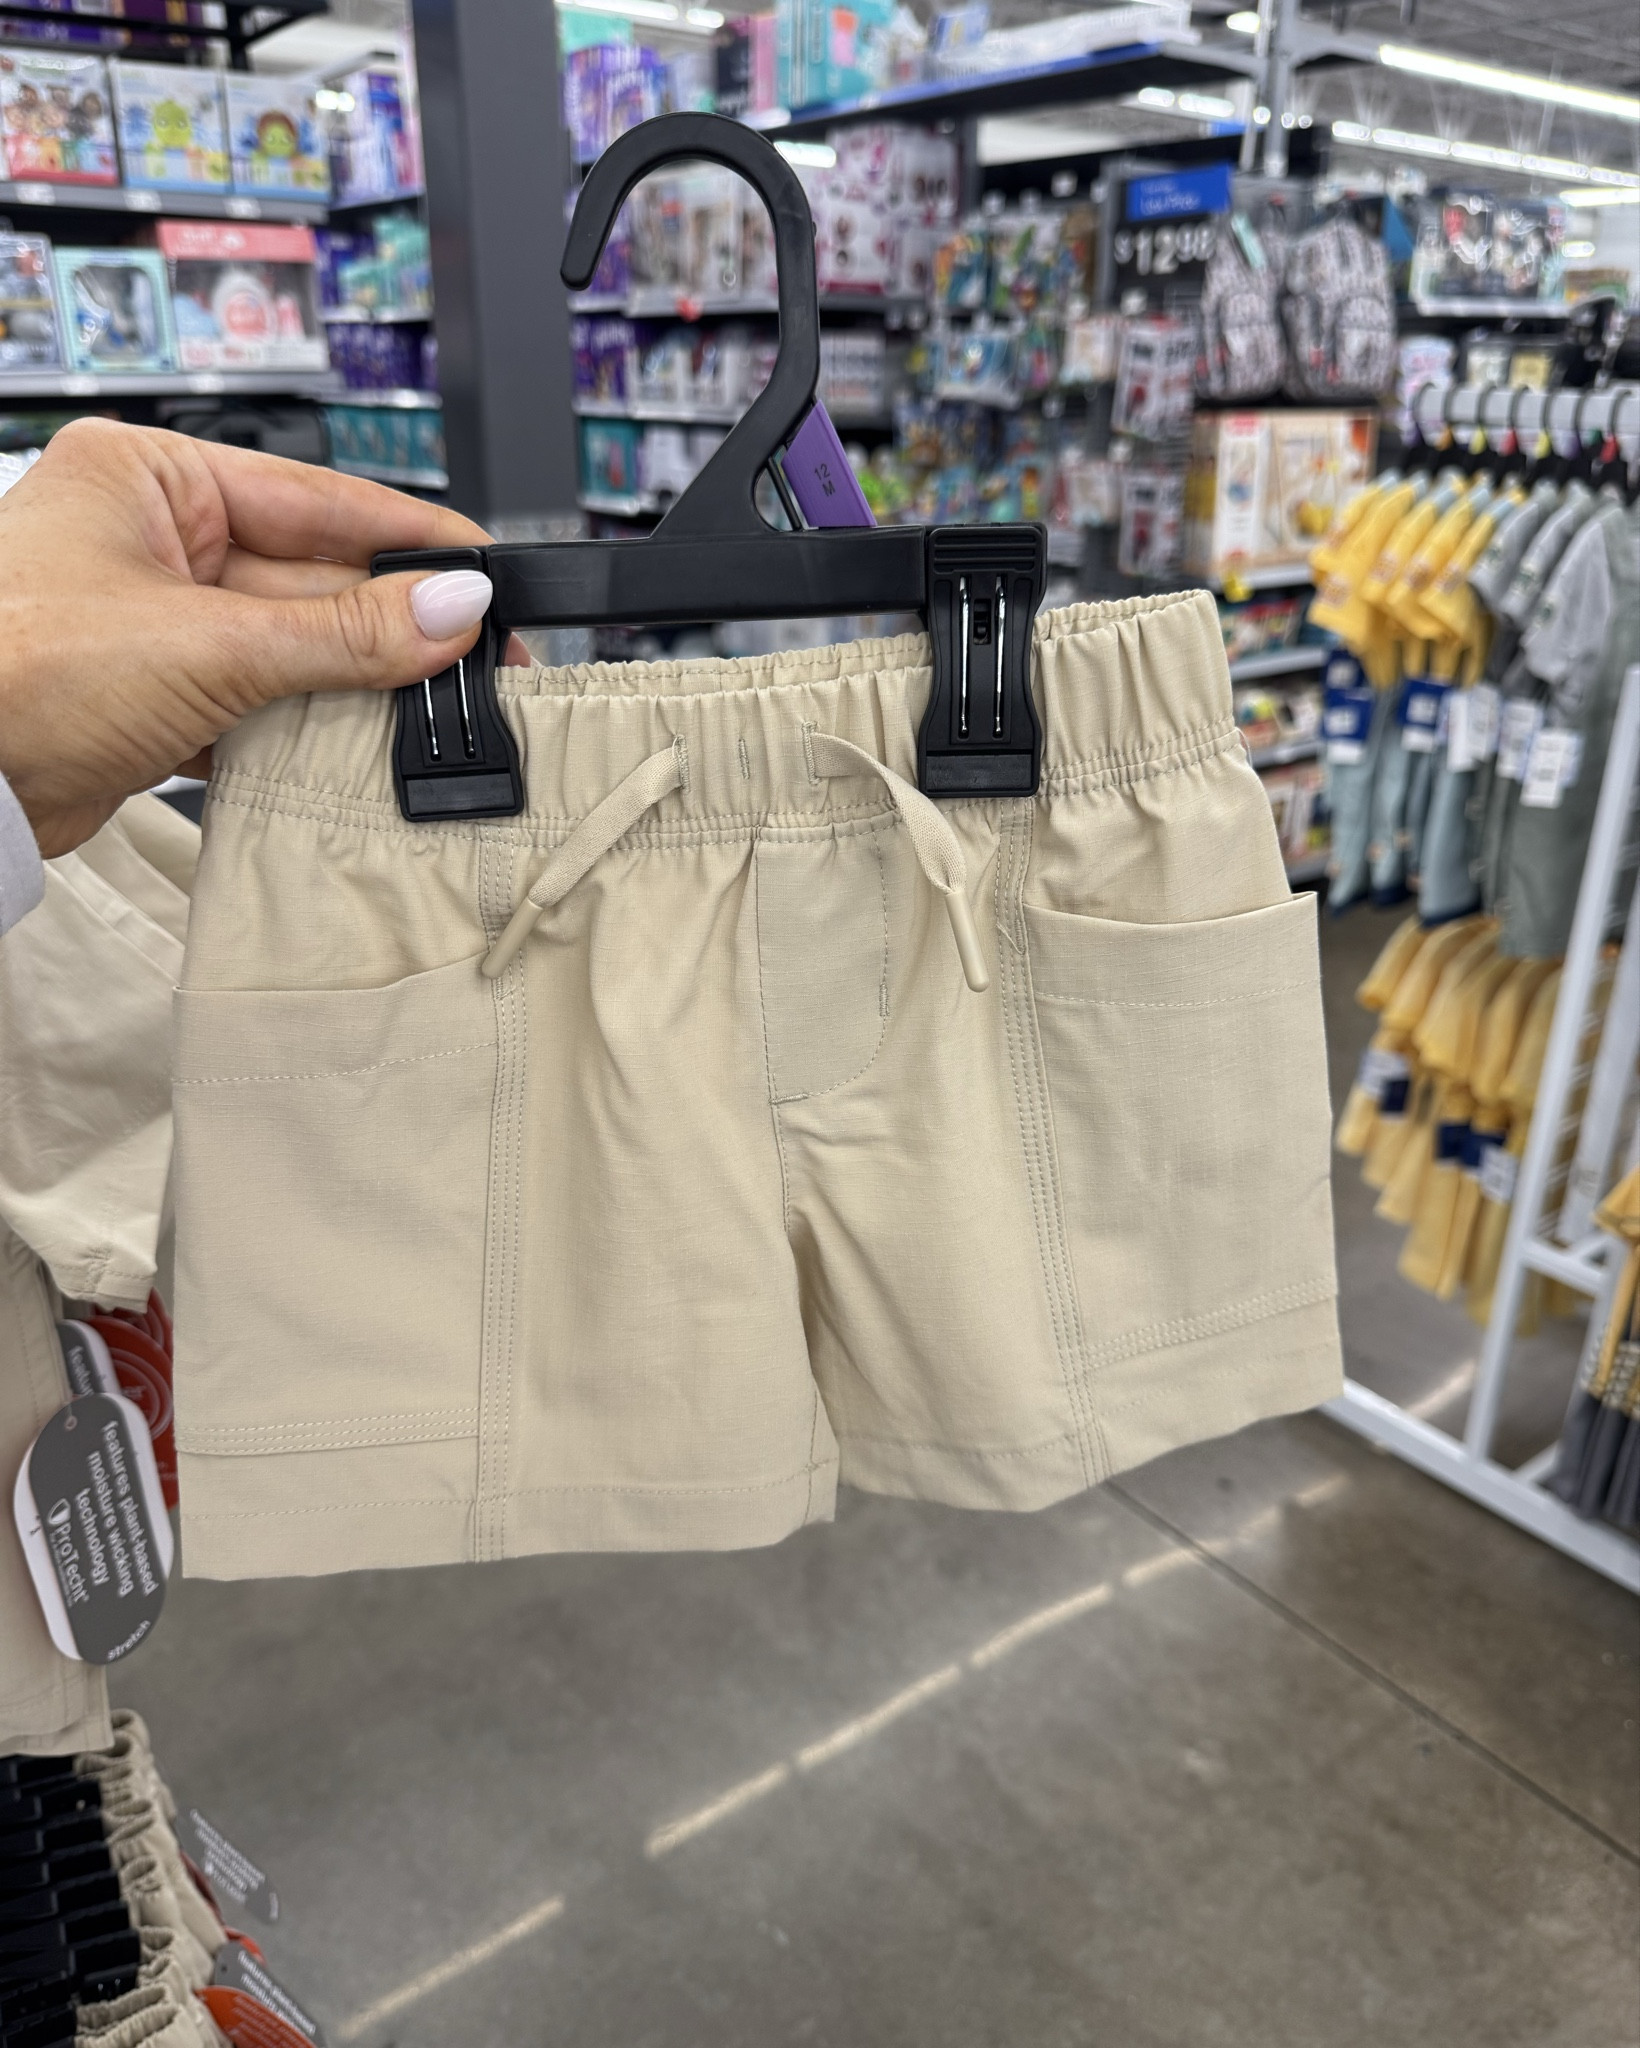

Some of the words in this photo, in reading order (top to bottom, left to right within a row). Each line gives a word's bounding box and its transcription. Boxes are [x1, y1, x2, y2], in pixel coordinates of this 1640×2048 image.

[814, 463, 830, 480] 12
[822, 480, 836, 497] M
[75, 1487, 110, 1585] technology
[87, 1450, 117, 1529] moisture
[108, 1527, 134, 1597] wicking
[102, 1420, 131, 1497] features
[118, 1496, 159, 1596] plant-based
[107, 1620, 151, 1660] stretch
